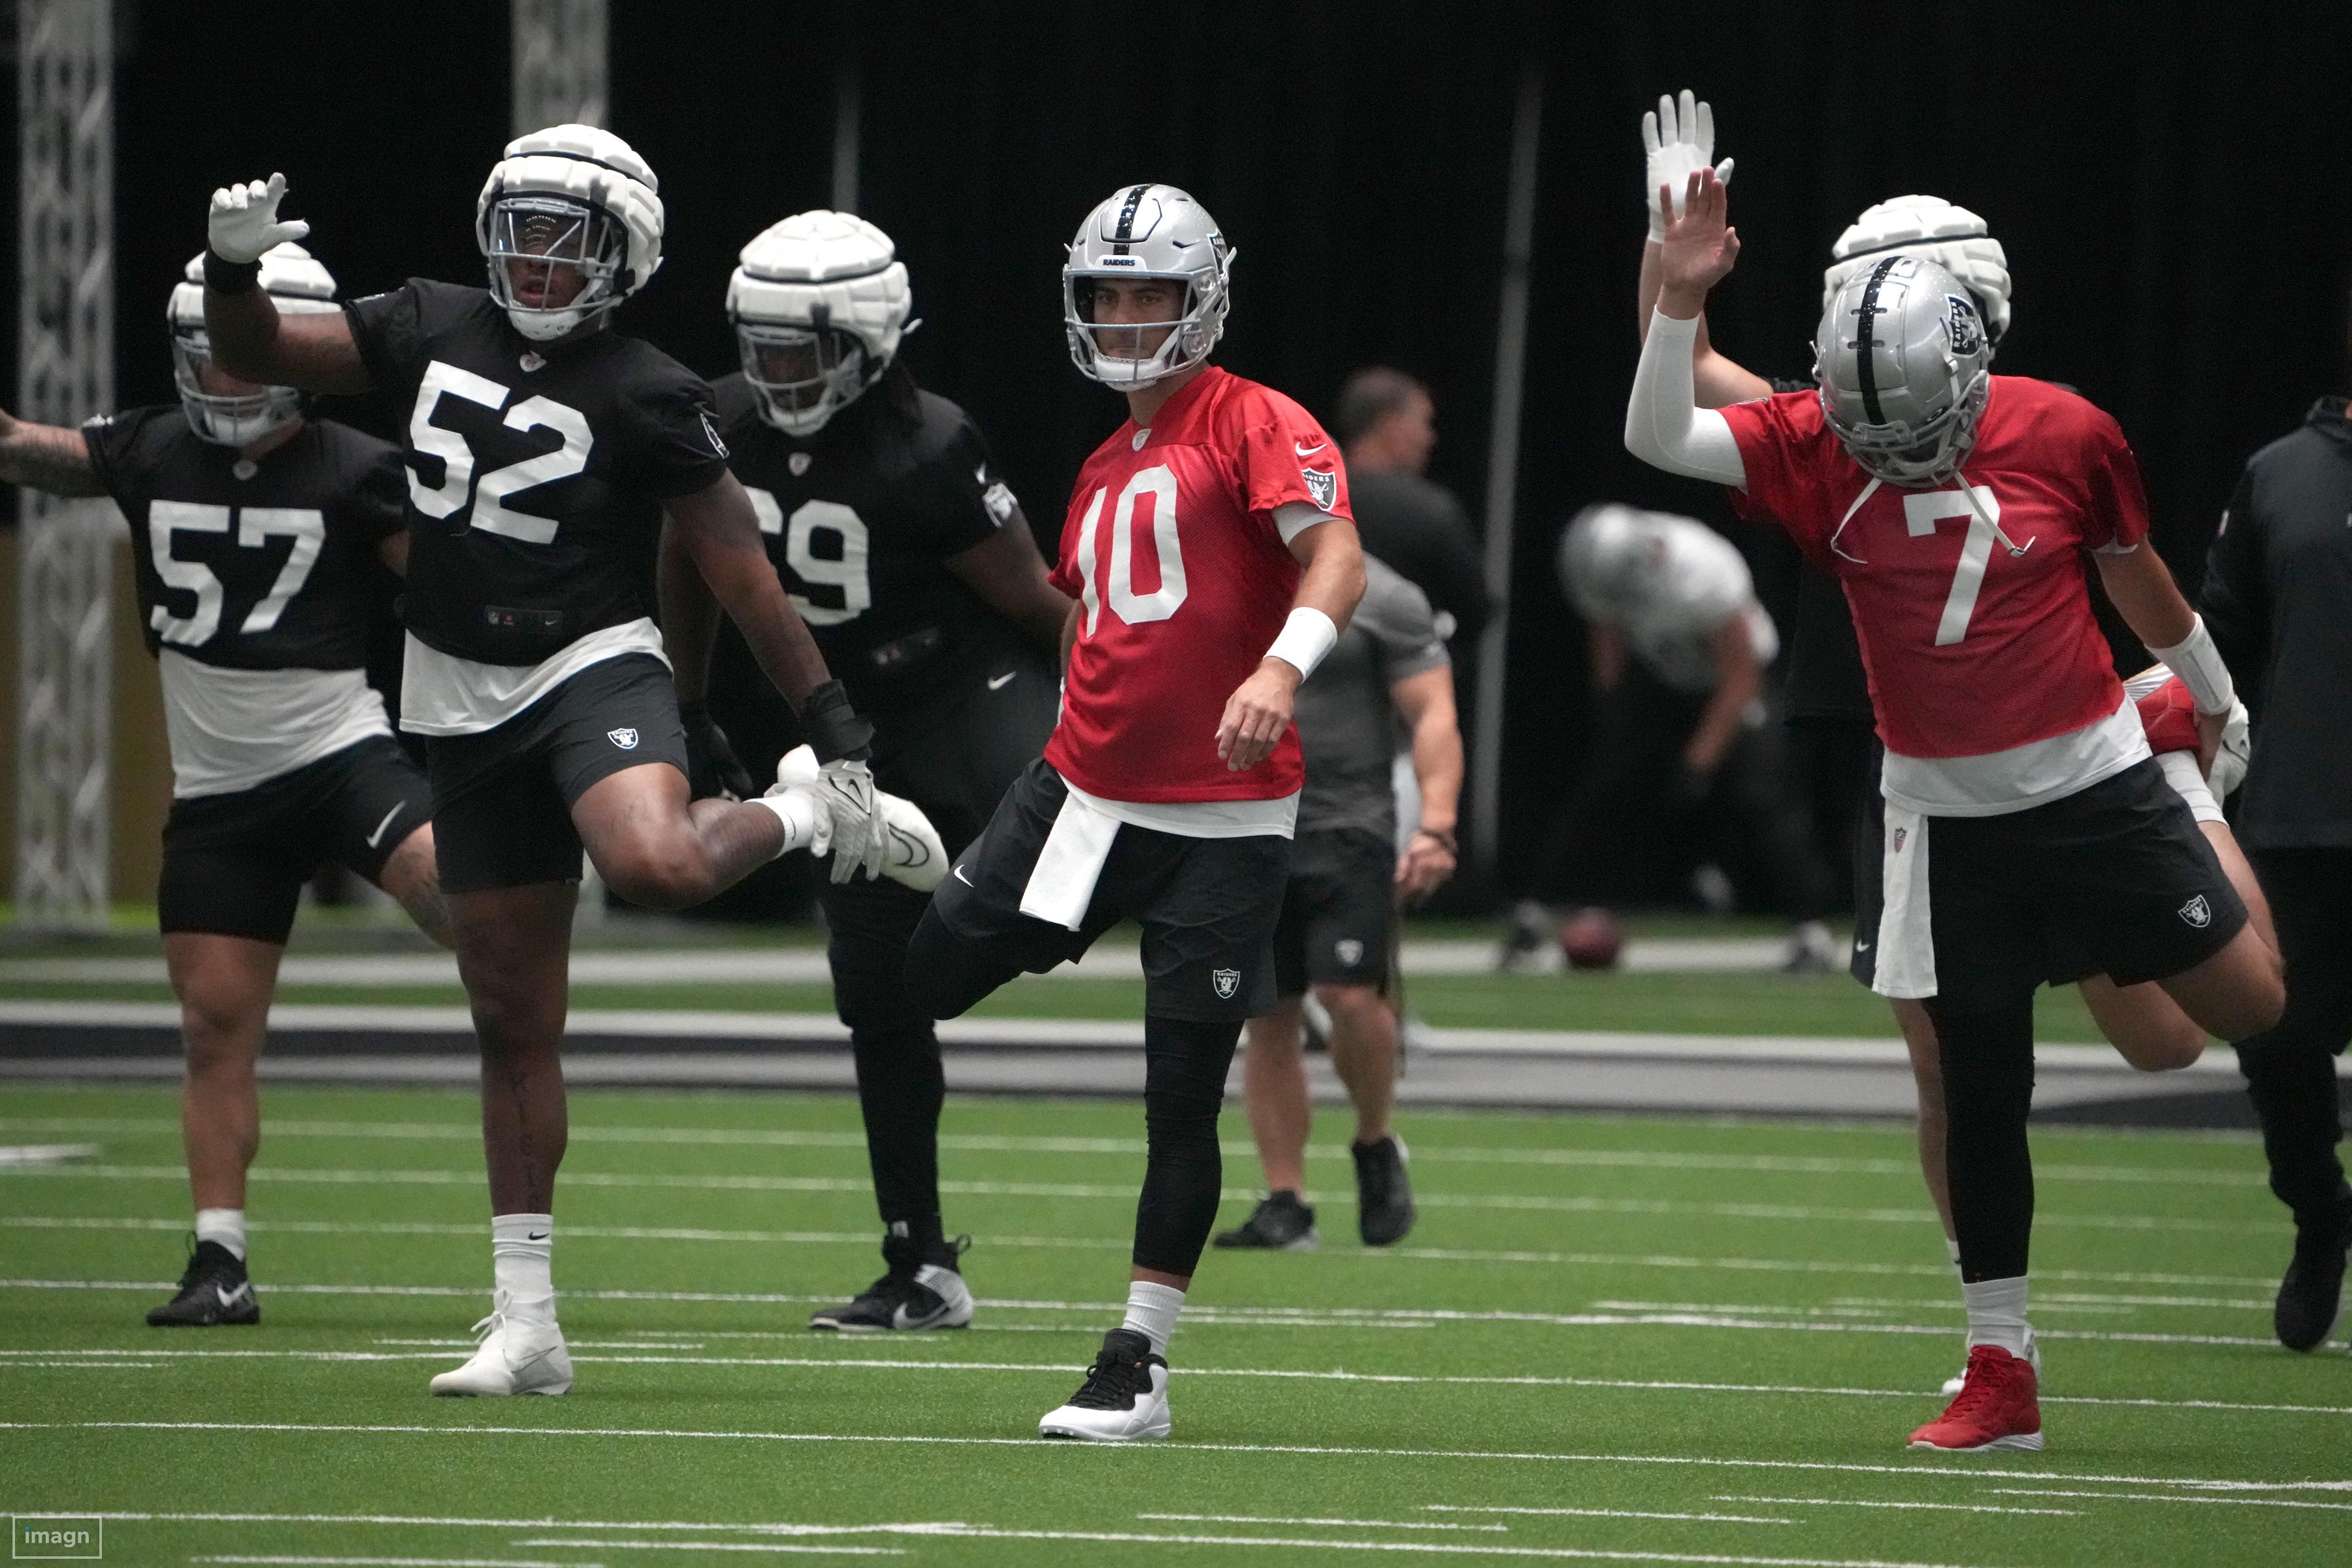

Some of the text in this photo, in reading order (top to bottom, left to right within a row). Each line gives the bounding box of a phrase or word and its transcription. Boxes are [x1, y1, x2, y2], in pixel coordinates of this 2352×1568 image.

[404, 360, 594, 544] 52
[149, 499, 325, 647] 57
[742, 485, 872, 626] 9
[1077, 463, 1188, 638] 10
[1903, 485, 2001, 646] 7
